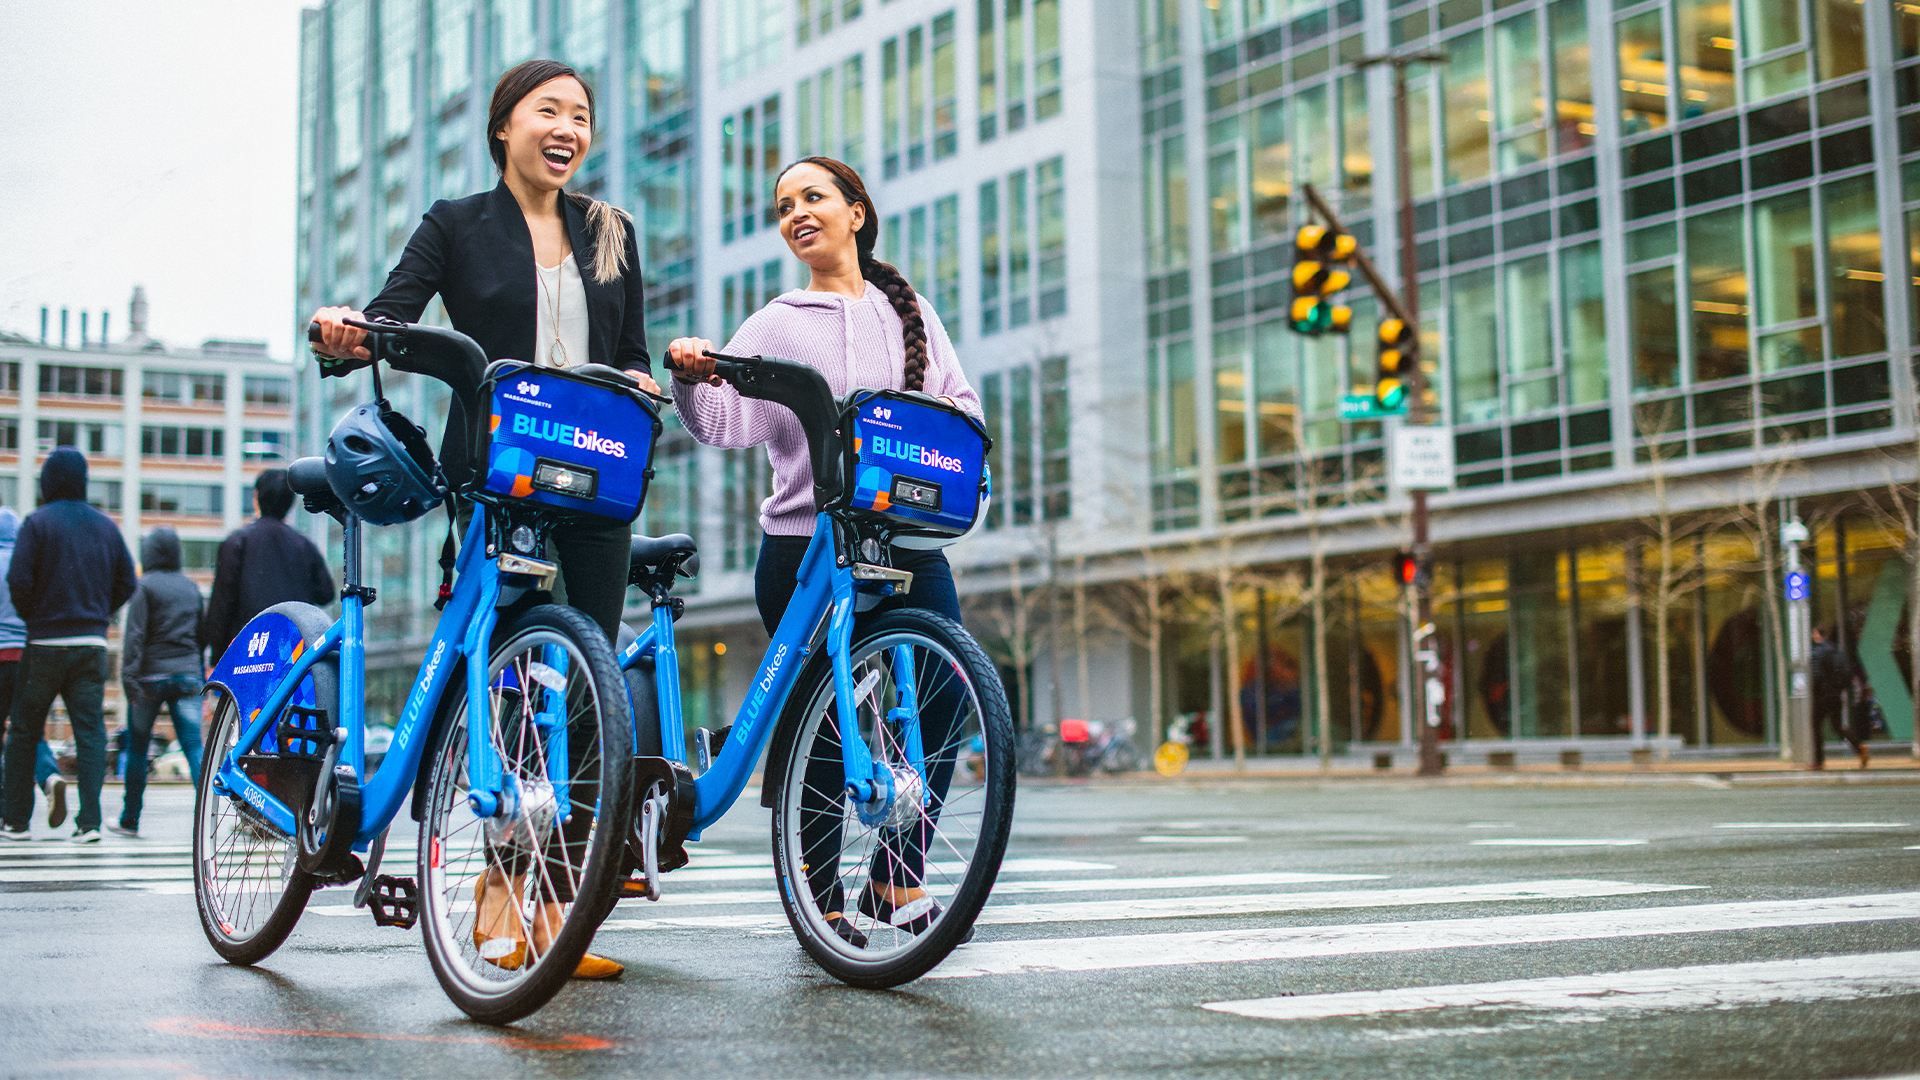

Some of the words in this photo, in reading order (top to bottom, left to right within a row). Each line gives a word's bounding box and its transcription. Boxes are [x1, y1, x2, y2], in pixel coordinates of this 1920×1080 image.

[503, 393, 552, 409] MASSACHUSETTS
[862, 417, 903, 431] MASSACHUSETTS
[233, 662, 275, 675] MASSACHUSETTS
[243, 786, 266, 811] 40894
